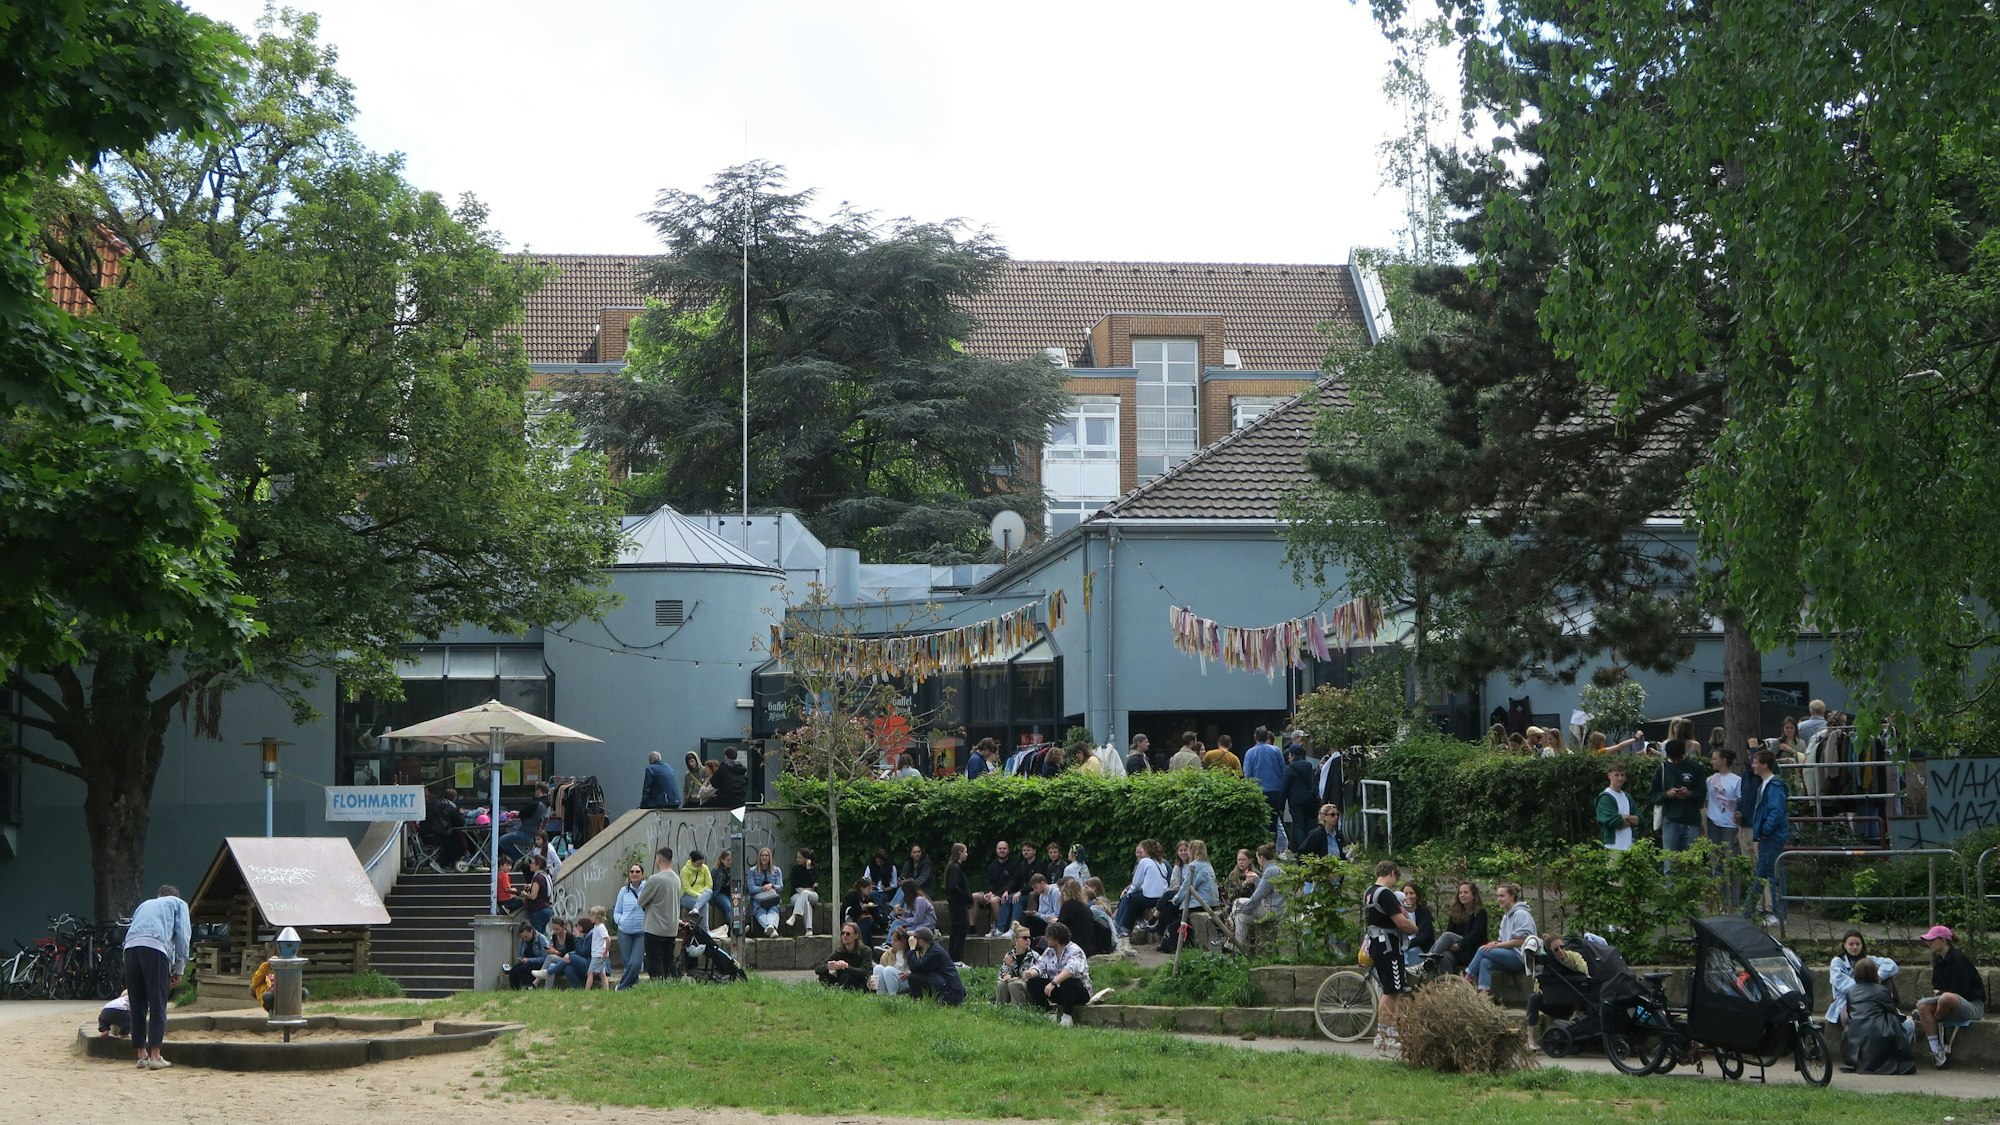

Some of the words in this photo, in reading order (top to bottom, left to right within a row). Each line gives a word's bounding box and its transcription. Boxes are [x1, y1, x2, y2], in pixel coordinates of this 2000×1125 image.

[768, 701, 787, 711] Gaffel
[893, 695, 912, 706] Gaffel
[1931, 761, 2000, 798] MAK
[333, 793, 416, 808] FLOHMARKT
[1931, 800, 2000, 833] MAZ
